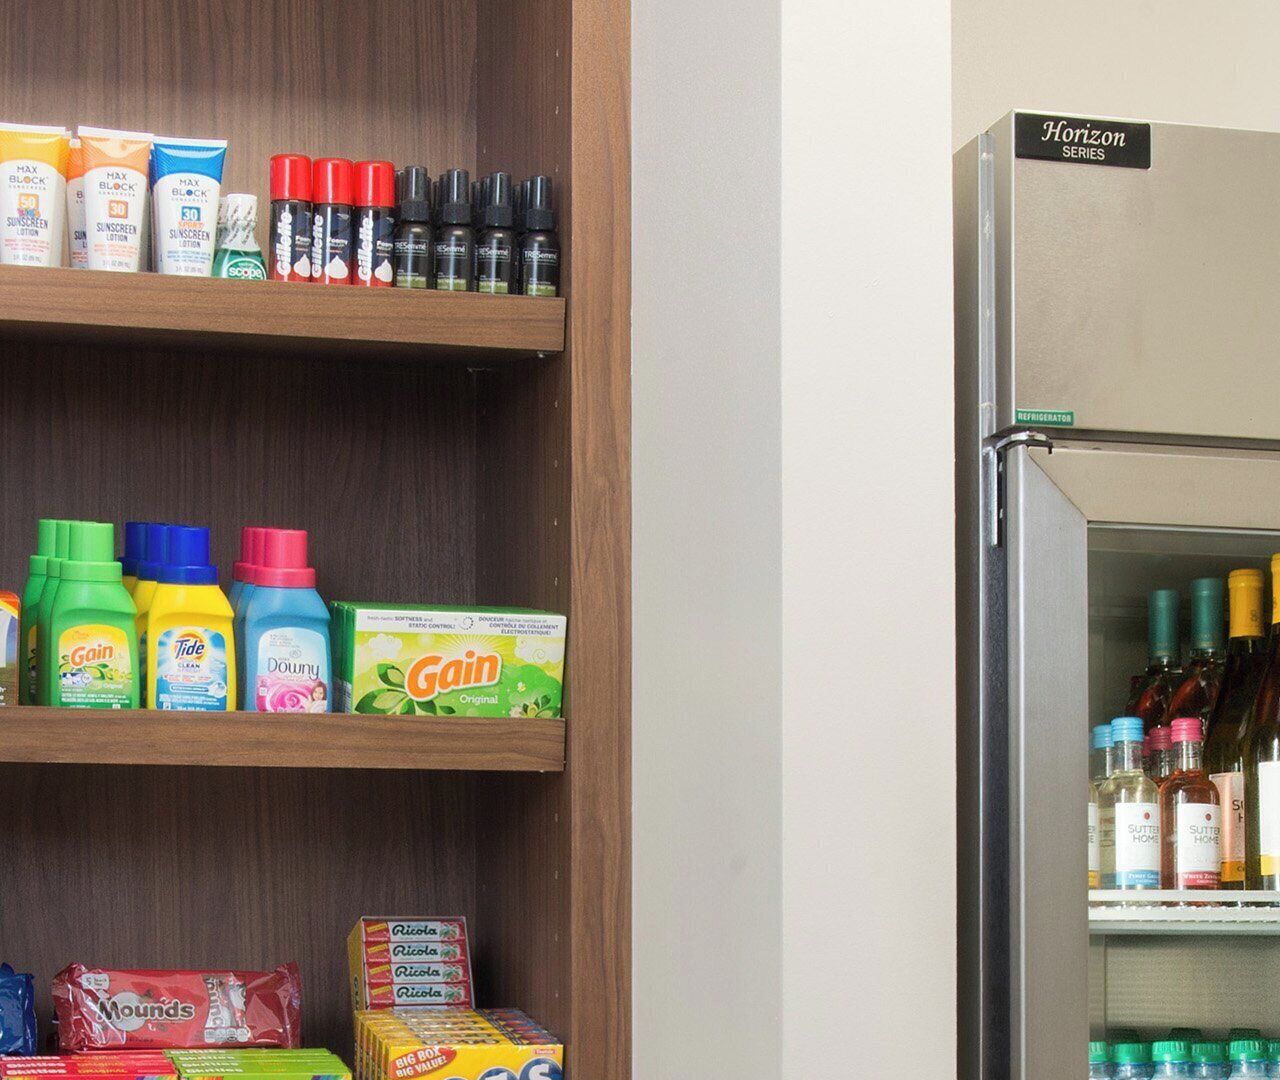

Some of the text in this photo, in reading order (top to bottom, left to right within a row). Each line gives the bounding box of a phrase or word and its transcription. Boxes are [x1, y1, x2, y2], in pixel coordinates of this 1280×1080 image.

[1041, 120, 1126, 148] Horizon
[1062, 146, 1106, 161] SERIES
[107, 172, 128, 182] MAX
[110, 202, 125, 216] 30
[7, 217, 49, 229] SUNSCREEN
[96, 222, 138, 236] SUNSCREEN
[106, 233, 129, 243] LOTION
[169, 229, 211, 242] SUNSCREEN
[1017, 411, 1072, 423] REFRIGERATOR
[174, 636, 206, 660] Tide
[70, 643, 115, 668] Gain
[267, 657, 321, 681] Downy
[407, 648, 499, 701] Gain
[459, 693, 499, 706] Original
[391, 924, 438, 937] Ricola
[394, 965, 441, 979] Ricola
[396, 986, 443, 1000] Ricola
[96, 997, 195, 1025] Mounds
[395, 1046, 444, 1068] BIG BOX
[395, 1056, 448, 1078] BIG VALUE!
